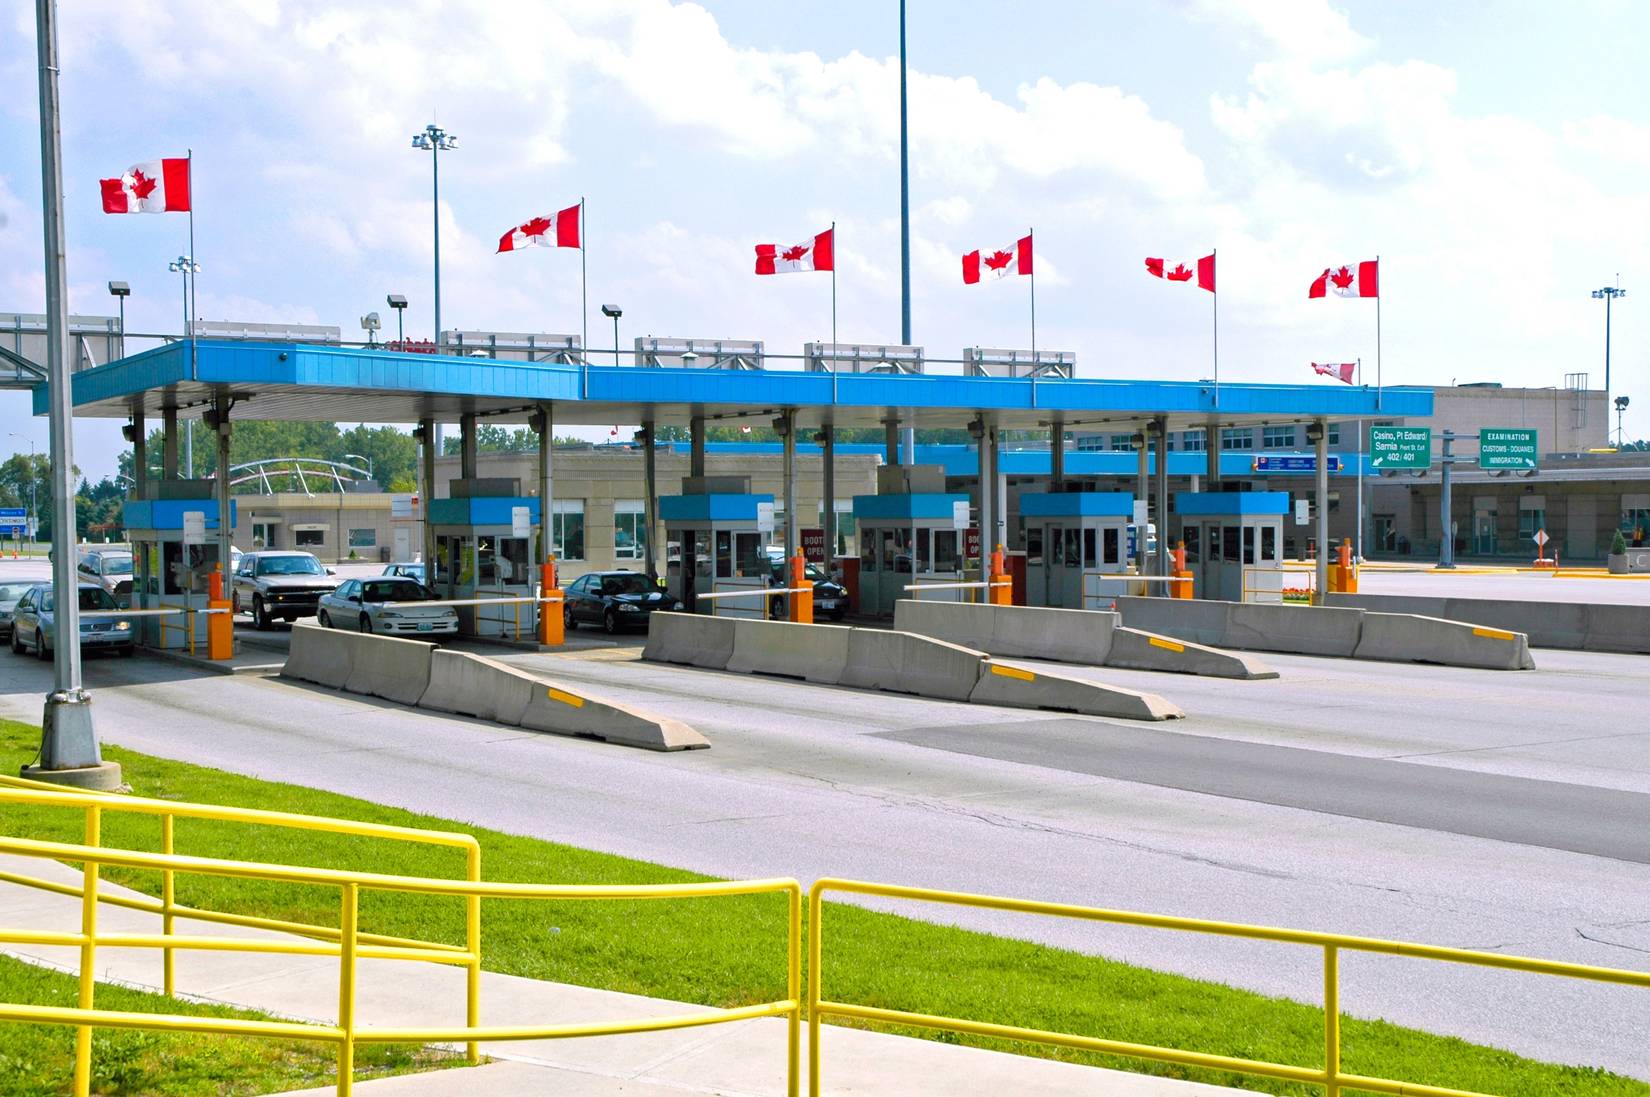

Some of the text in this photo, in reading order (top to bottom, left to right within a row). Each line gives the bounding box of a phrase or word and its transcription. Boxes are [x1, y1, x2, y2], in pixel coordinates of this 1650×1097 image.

[1373, 431, 1396, 441] Casino,
[1375, 441, 1398, 451] Sarnia
[1482, 445, 1507, 453] CUSTOMS
[1510, 445, 1534, 453] DOUANES
